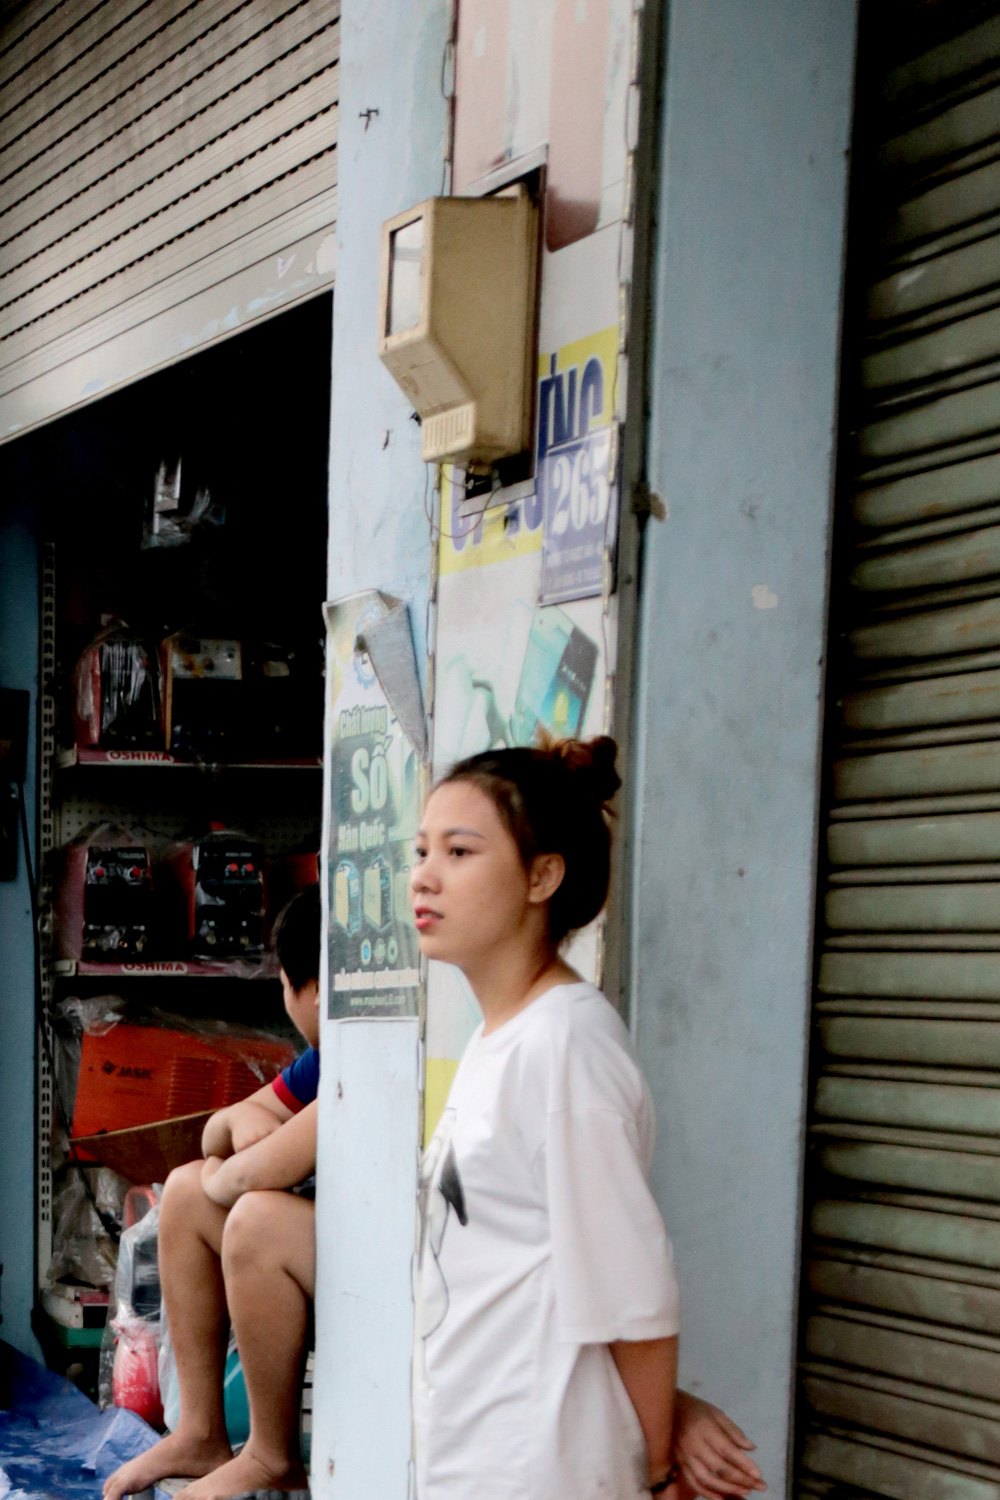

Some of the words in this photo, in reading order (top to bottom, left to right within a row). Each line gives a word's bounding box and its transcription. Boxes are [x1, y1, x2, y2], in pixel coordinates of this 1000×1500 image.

[552, 443, 610, 535] 265
[108, 750, 172, 762] OSHIMA
[124, 962, 185, 973] OSHIMA
